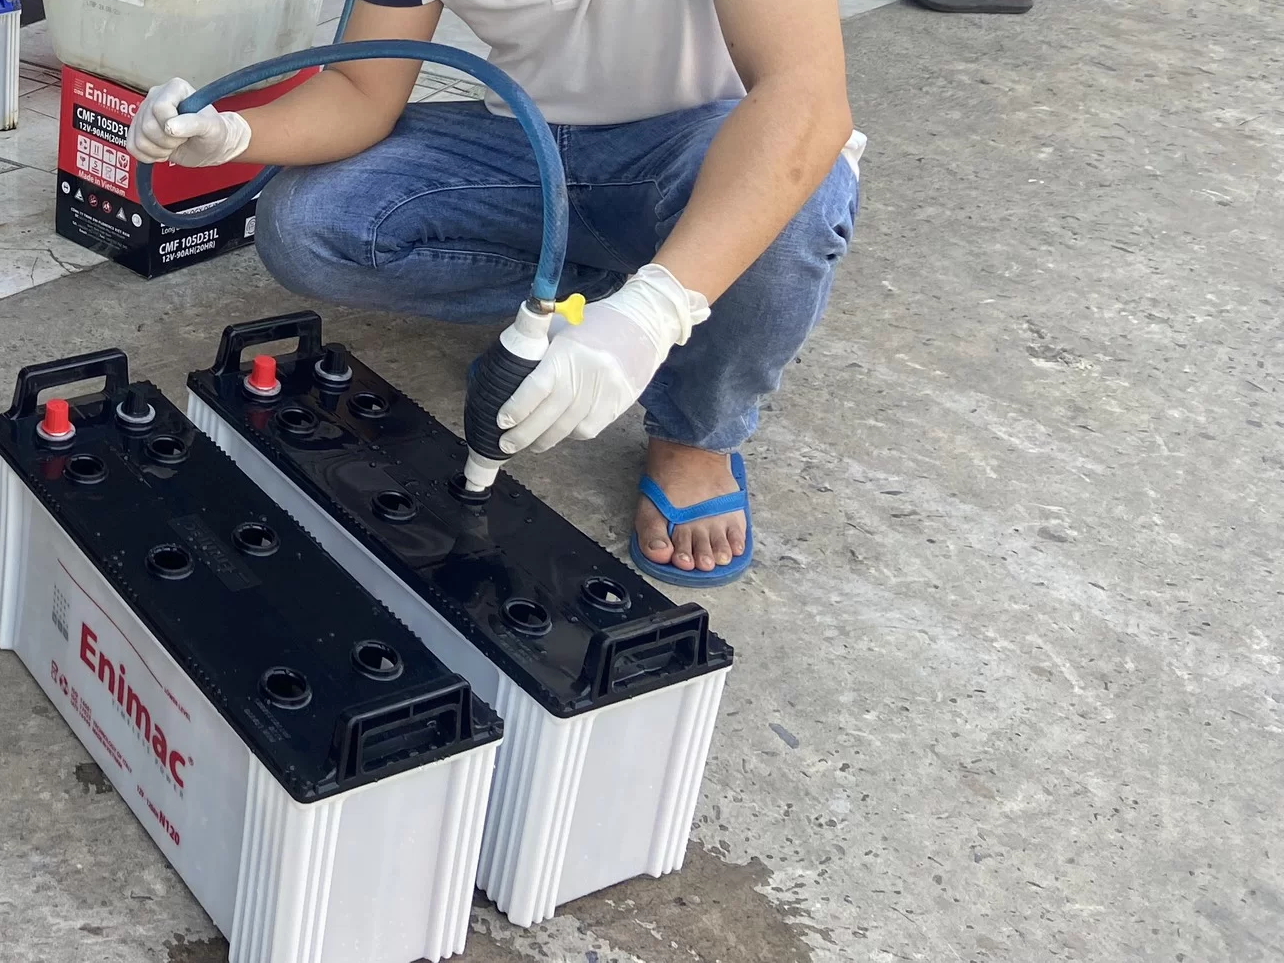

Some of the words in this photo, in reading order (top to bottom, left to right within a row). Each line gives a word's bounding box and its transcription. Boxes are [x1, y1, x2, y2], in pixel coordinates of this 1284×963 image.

[85, 83, 136, 116] Enimac
[77, 108, 95, 123] CMF
[97, 116, 128, 137] 105D31
[79, 122, 126, 147] 12V-90AH(20HR
[79, 170, 94, 183] Made
[101, 180, 125, 197] Vietnam
[159, 240, 179, 254] CMF
[181, 228, 219, 248] 105D31L
[161, 227, 175, 235] Long
[162, 241, 216, 263] 12V-90AH(20HR)
[80, 622, 186, 789] Enimac
[159, 810, 180, 846] N120
